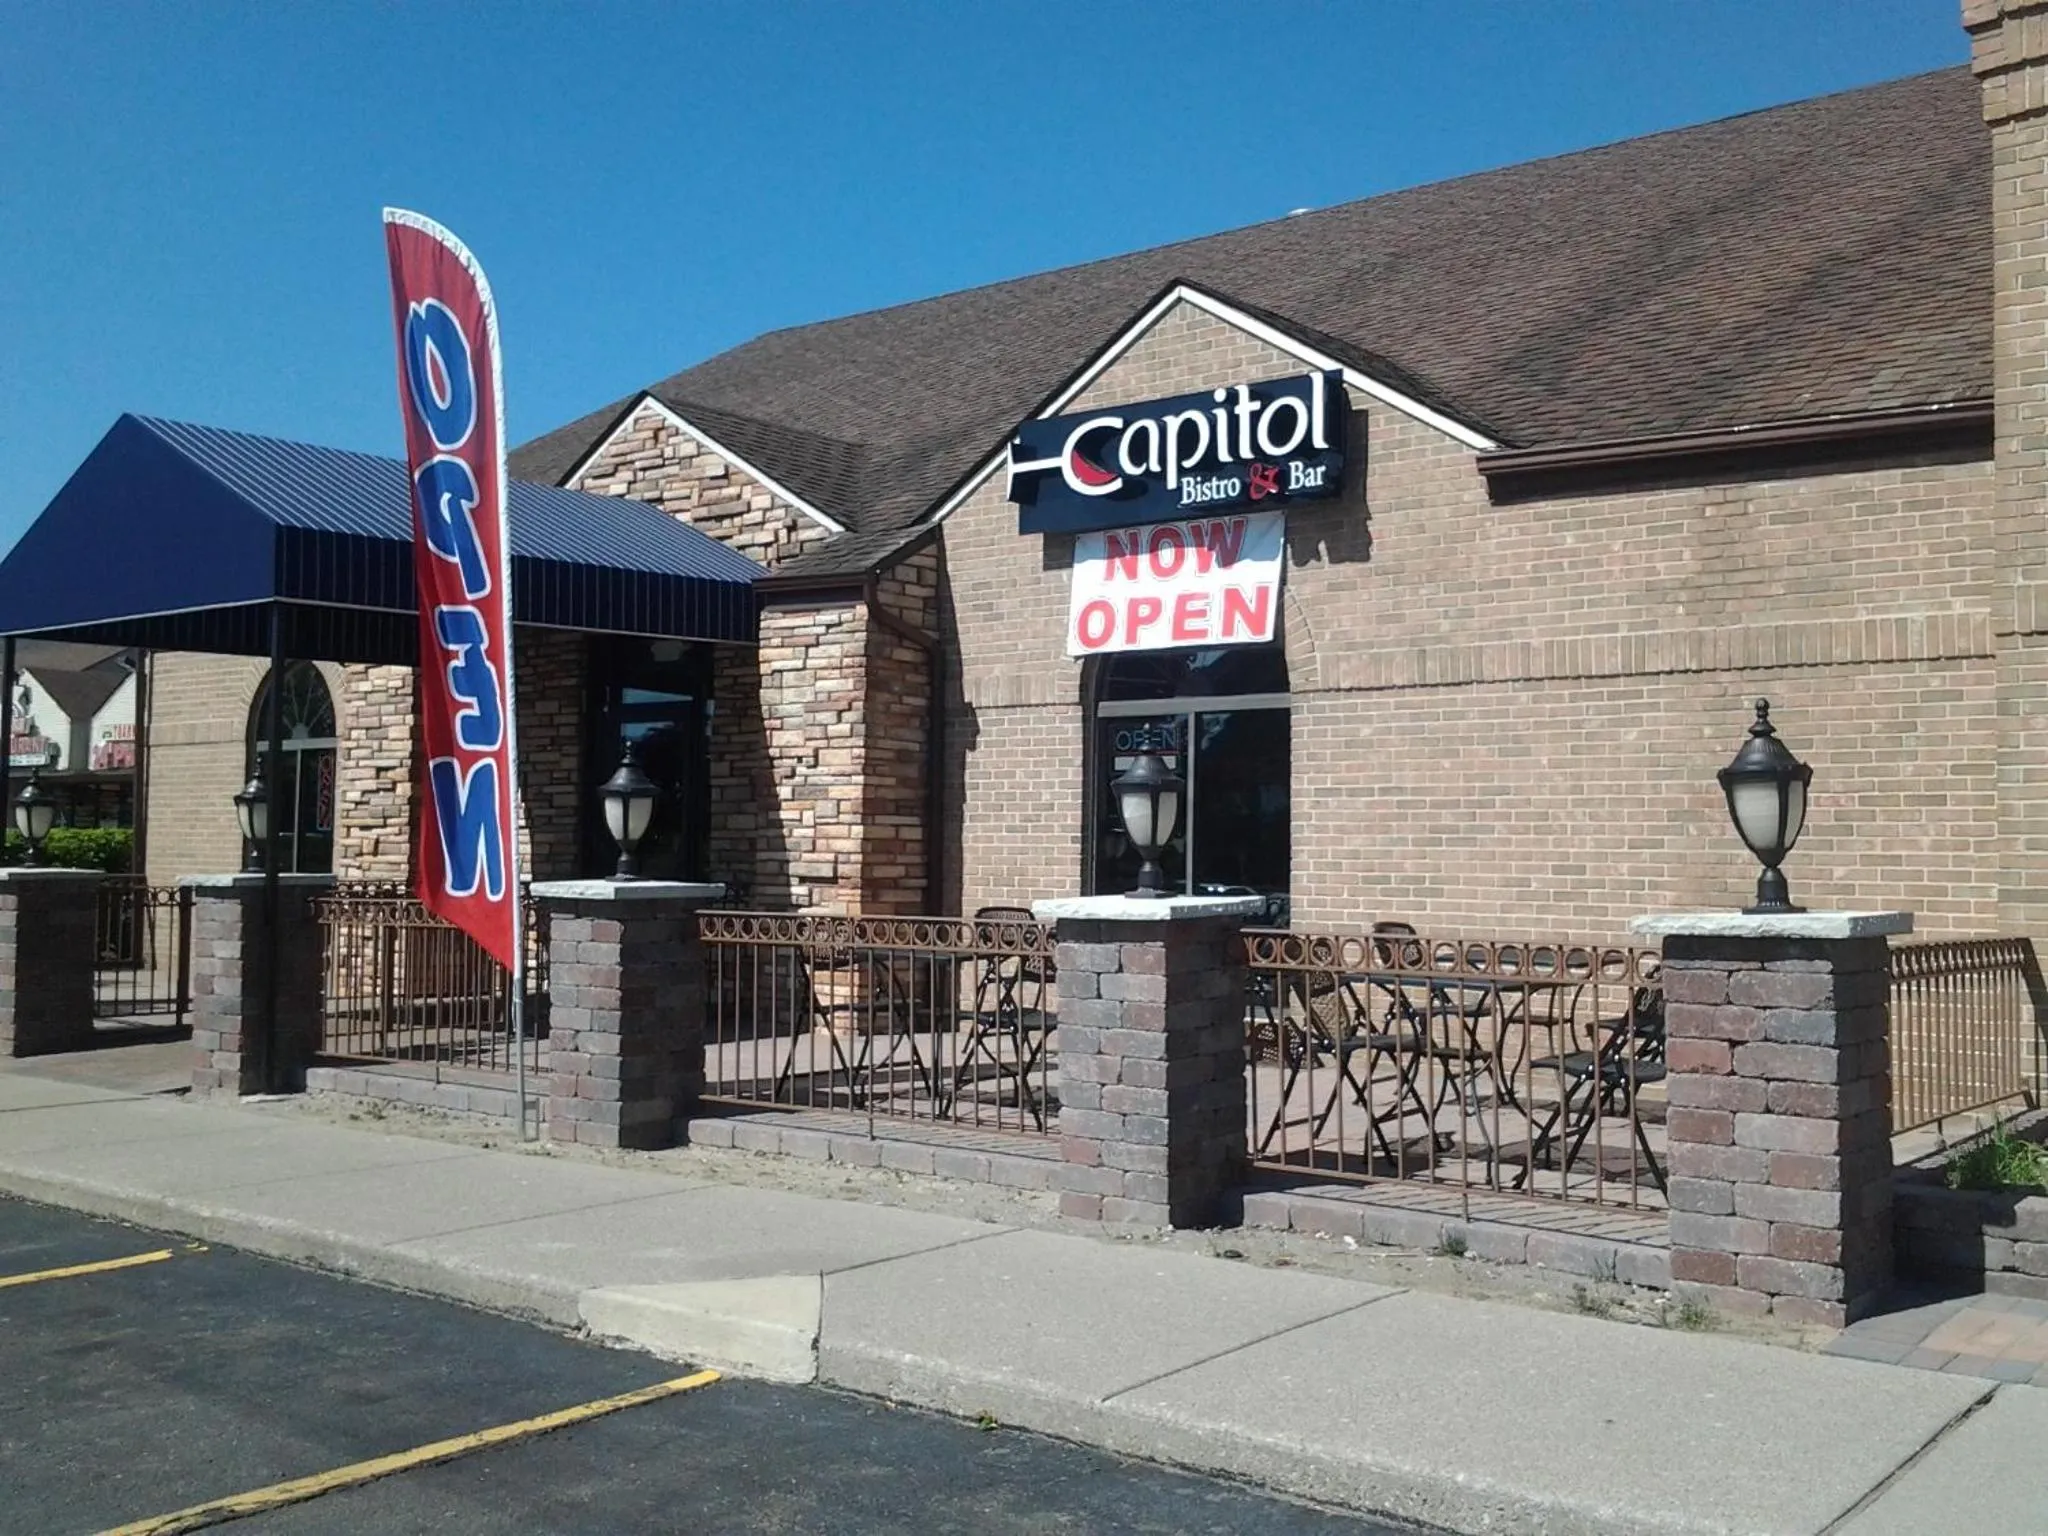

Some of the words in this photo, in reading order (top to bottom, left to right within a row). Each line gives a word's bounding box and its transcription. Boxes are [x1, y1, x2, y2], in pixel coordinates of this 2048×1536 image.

[1061, 371, 1329, 496] Capitol
[1179, 475, 1240, 506] Bistro
[1248, 462, 1279, 501] &
[1287, 461, 1327, 491] Bar
[1103, 517, 1248, 583] NOW
[1075, 585, 1272, 650] OPEN
